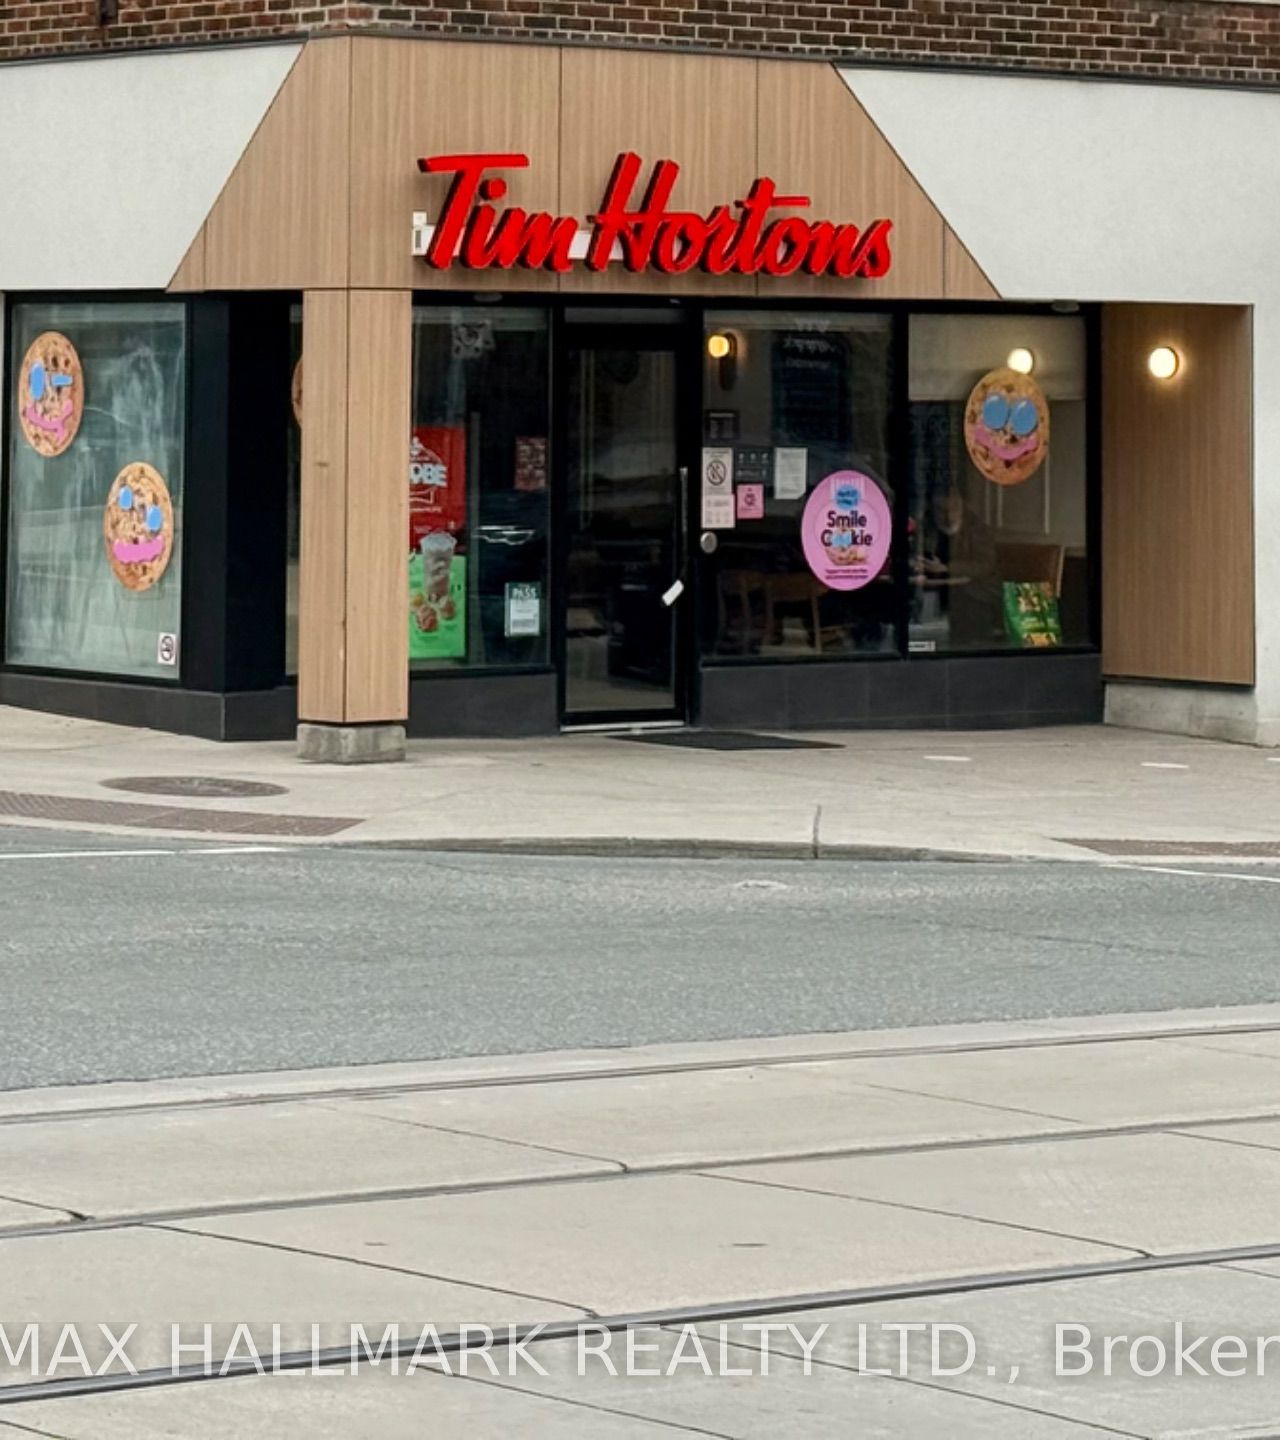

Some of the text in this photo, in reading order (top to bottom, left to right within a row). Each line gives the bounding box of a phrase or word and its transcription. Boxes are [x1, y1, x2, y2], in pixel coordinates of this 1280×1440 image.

[418, 151, 893, 279] Tim Hortons
[827, 510, 867, 527] Smile
[821, 529, 873, 547] Ckie
